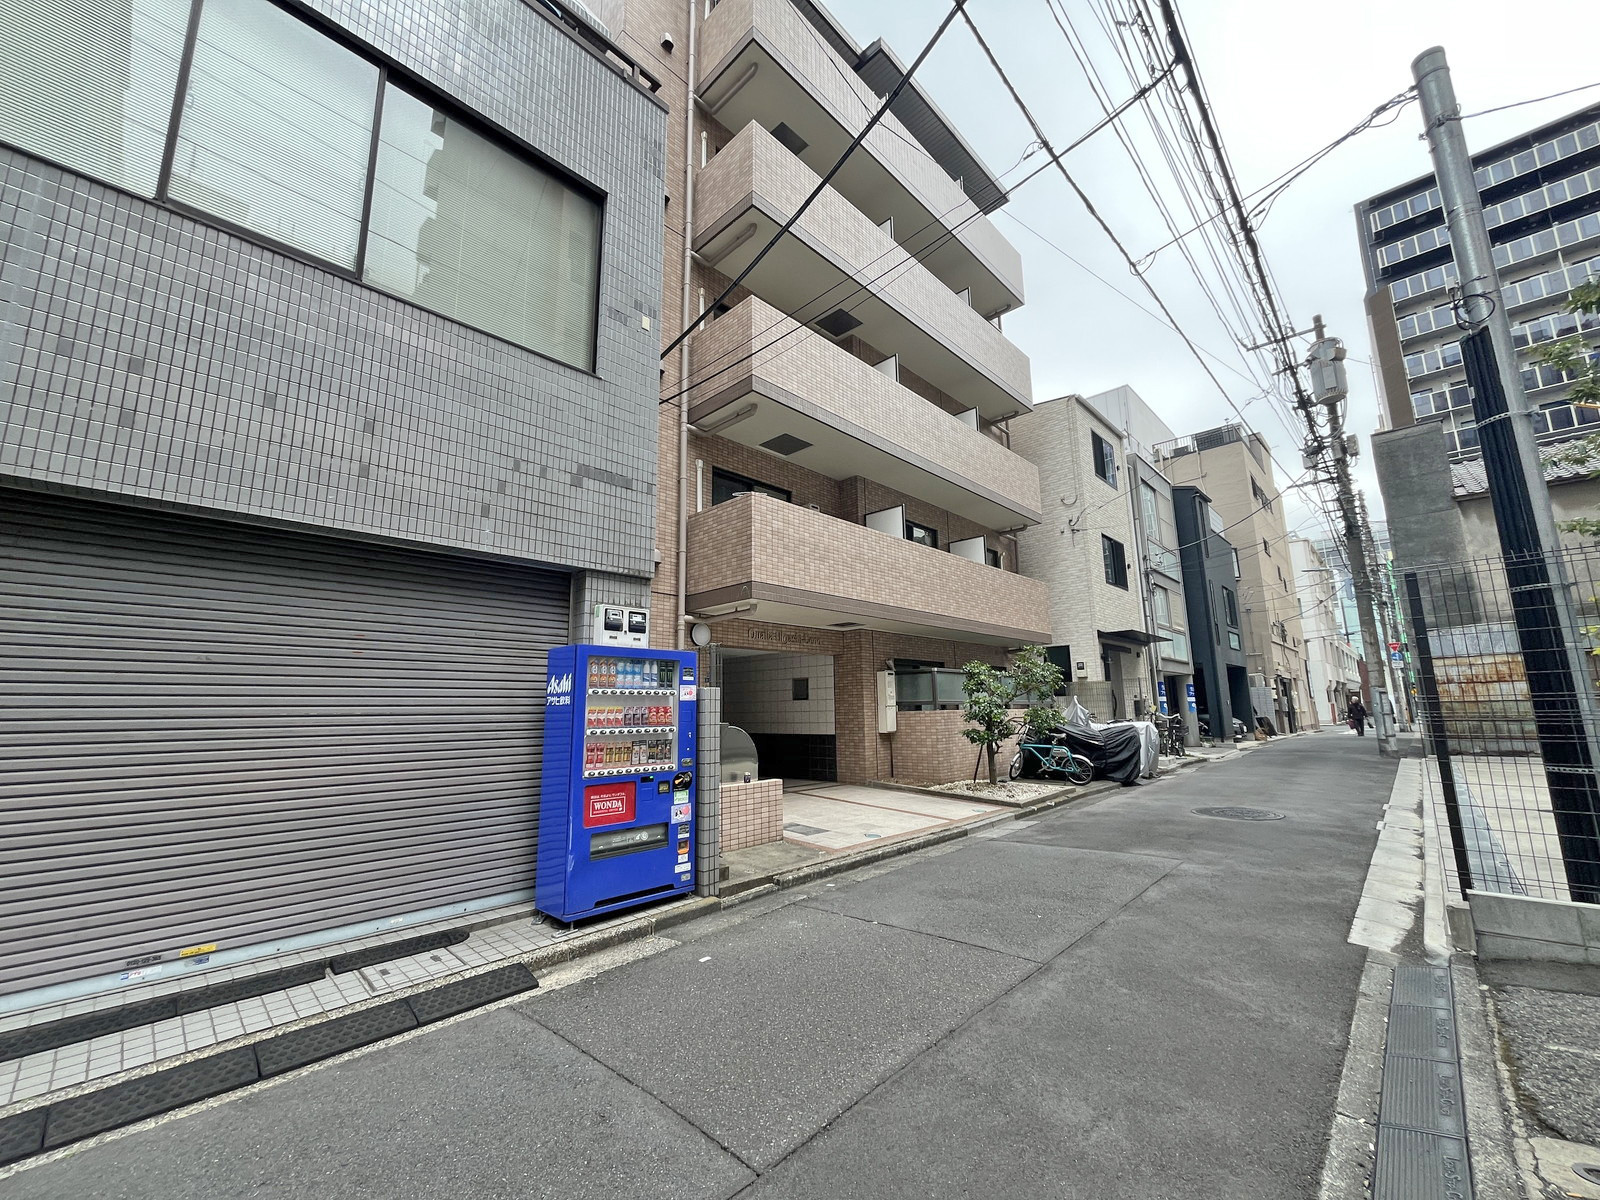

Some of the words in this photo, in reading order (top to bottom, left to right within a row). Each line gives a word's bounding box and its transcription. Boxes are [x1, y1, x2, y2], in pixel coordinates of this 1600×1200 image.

[547, 673, 572, 694] Asahi
[546, 695, 571, 706] アサヒ飲料
[593, 800, 622, 811] WONDA
